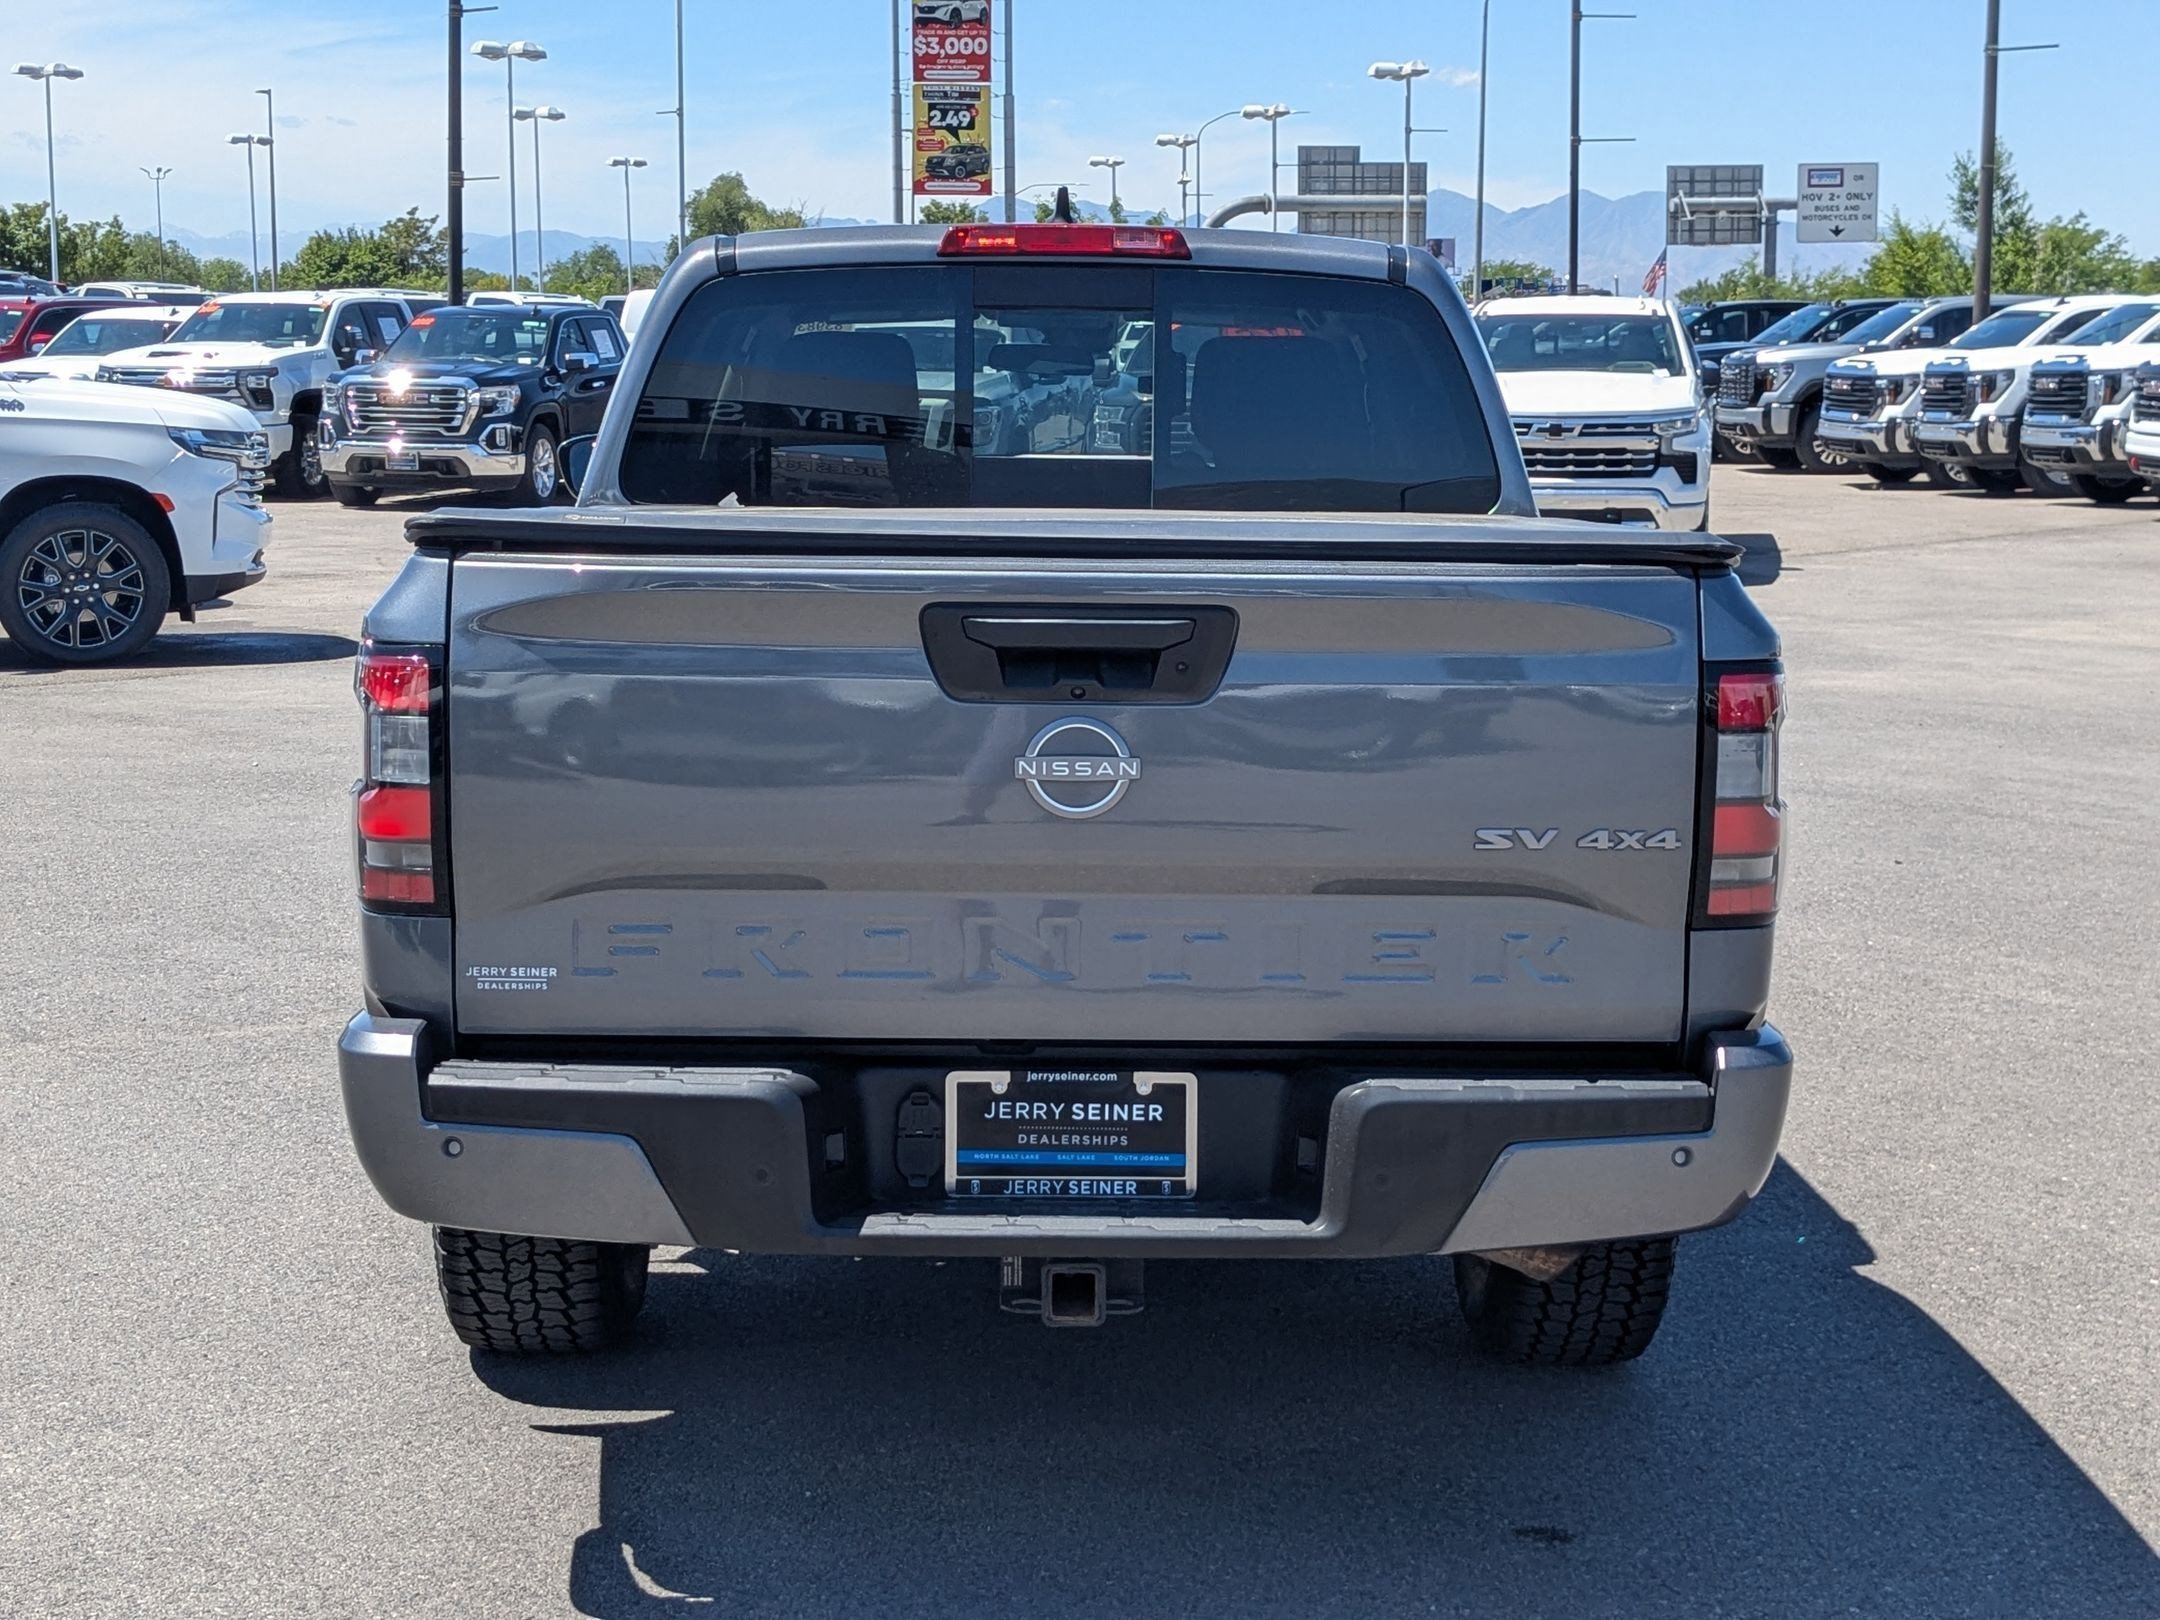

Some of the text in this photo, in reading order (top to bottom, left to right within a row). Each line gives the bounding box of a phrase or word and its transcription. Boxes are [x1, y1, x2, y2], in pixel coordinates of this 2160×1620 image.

[914, 35, 988, 58] $3,000
[1853, 174, 1864, 182] OR
[1801, 193, 1823, 202] HOV
[1845, 192, 1873, 201] ONLY
[1018, 761, 1137, 776] NISSAN
[1474, 828, 1682, 850] SV 4x4
[572, 910, 1574, 984] FRONTIER
[466, 966, 557, 977] JERRY SEINER
[477, 982, 547, 990] DEALERSHIPS
[1026, 1070, 1118, 1083] jerryseiner.com
[984, 1102, 1163, 1121] JERRY SEINER
[1017, 1134, 1128, 1146] DEALERSHIPS
[1003, 1181, 1064, 1194] JERRY
[1068, 1182, 1137, 1195] SEINER
